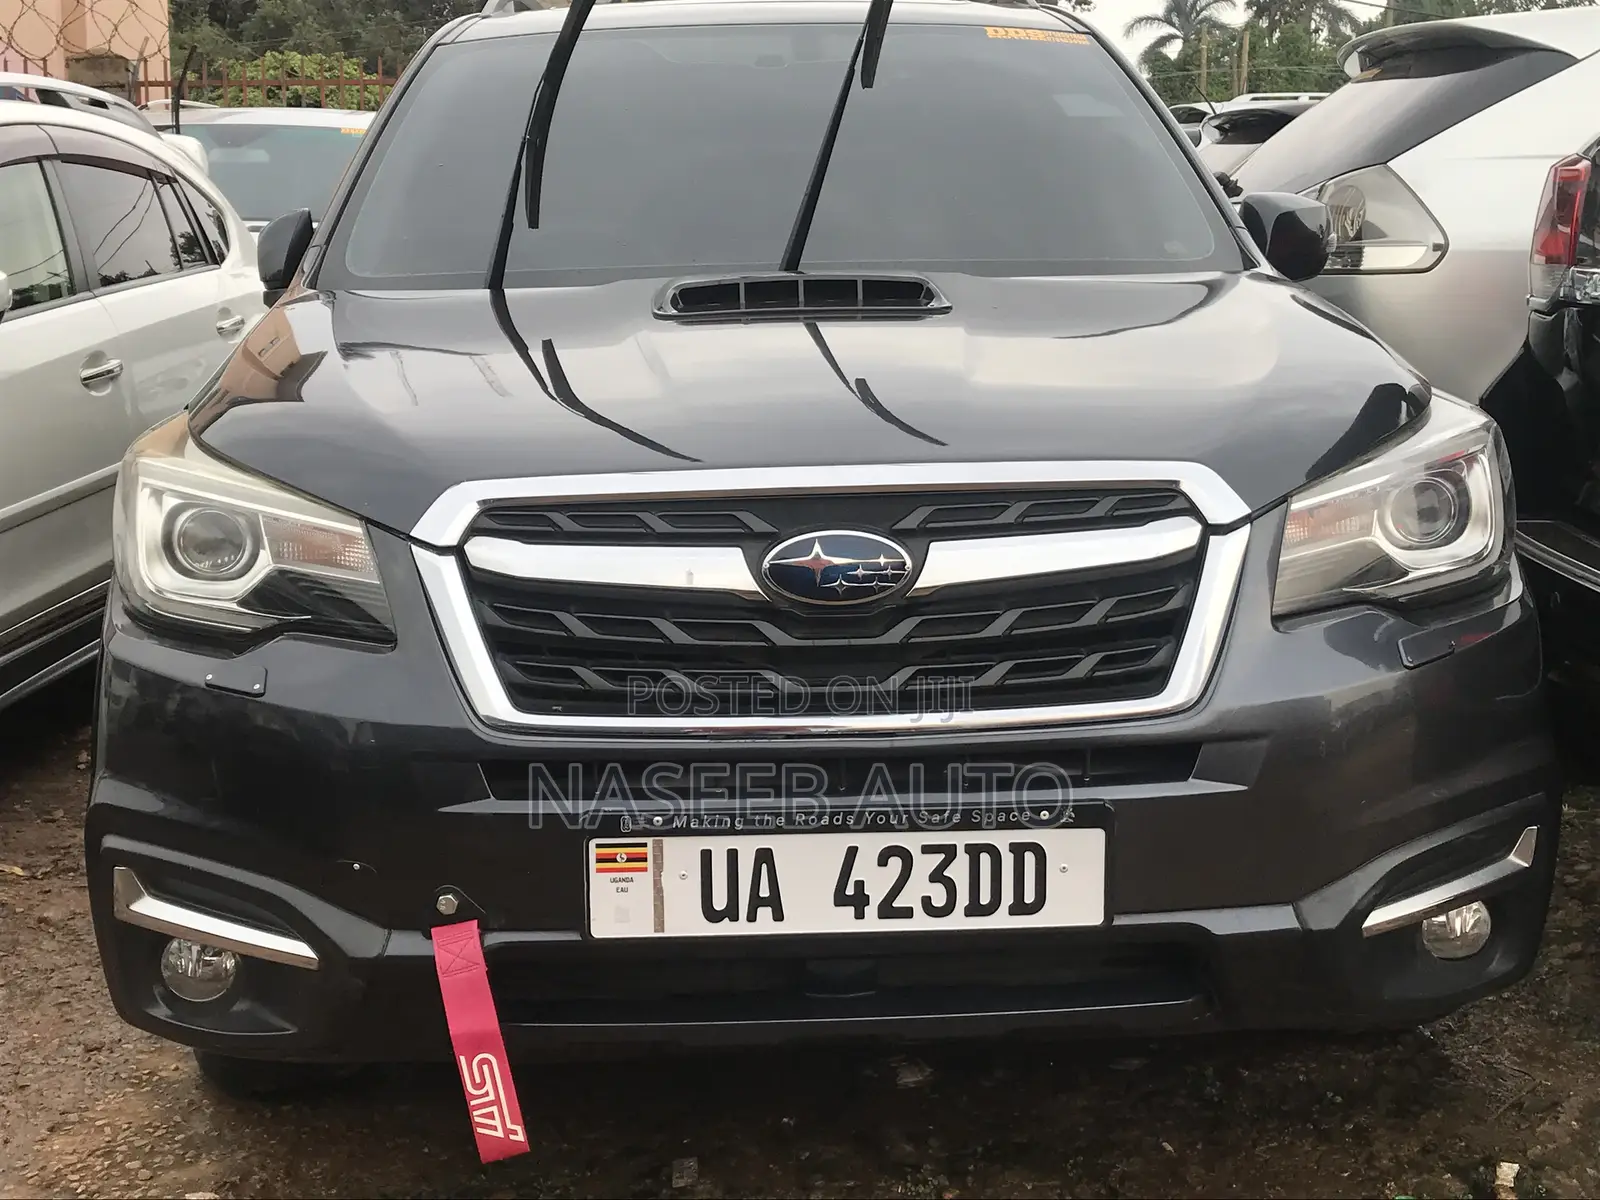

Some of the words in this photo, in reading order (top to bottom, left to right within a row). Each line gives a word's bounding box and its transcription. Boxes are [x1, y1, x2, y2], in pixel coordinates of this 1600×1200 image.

[672, 815, 744, 830] Making
[754, 814, 785, 827] the
[795, 812, 854, 826] Roads
[865, 811, 909, 825] Your
[919, 810, 962, 825] Safe
[971, 809, 1031, 825] Space
[609, 876, 635, 884] UGANDA
[700, 847, 785, 924] UA
[833, 841, 1048, 920] 423DD
